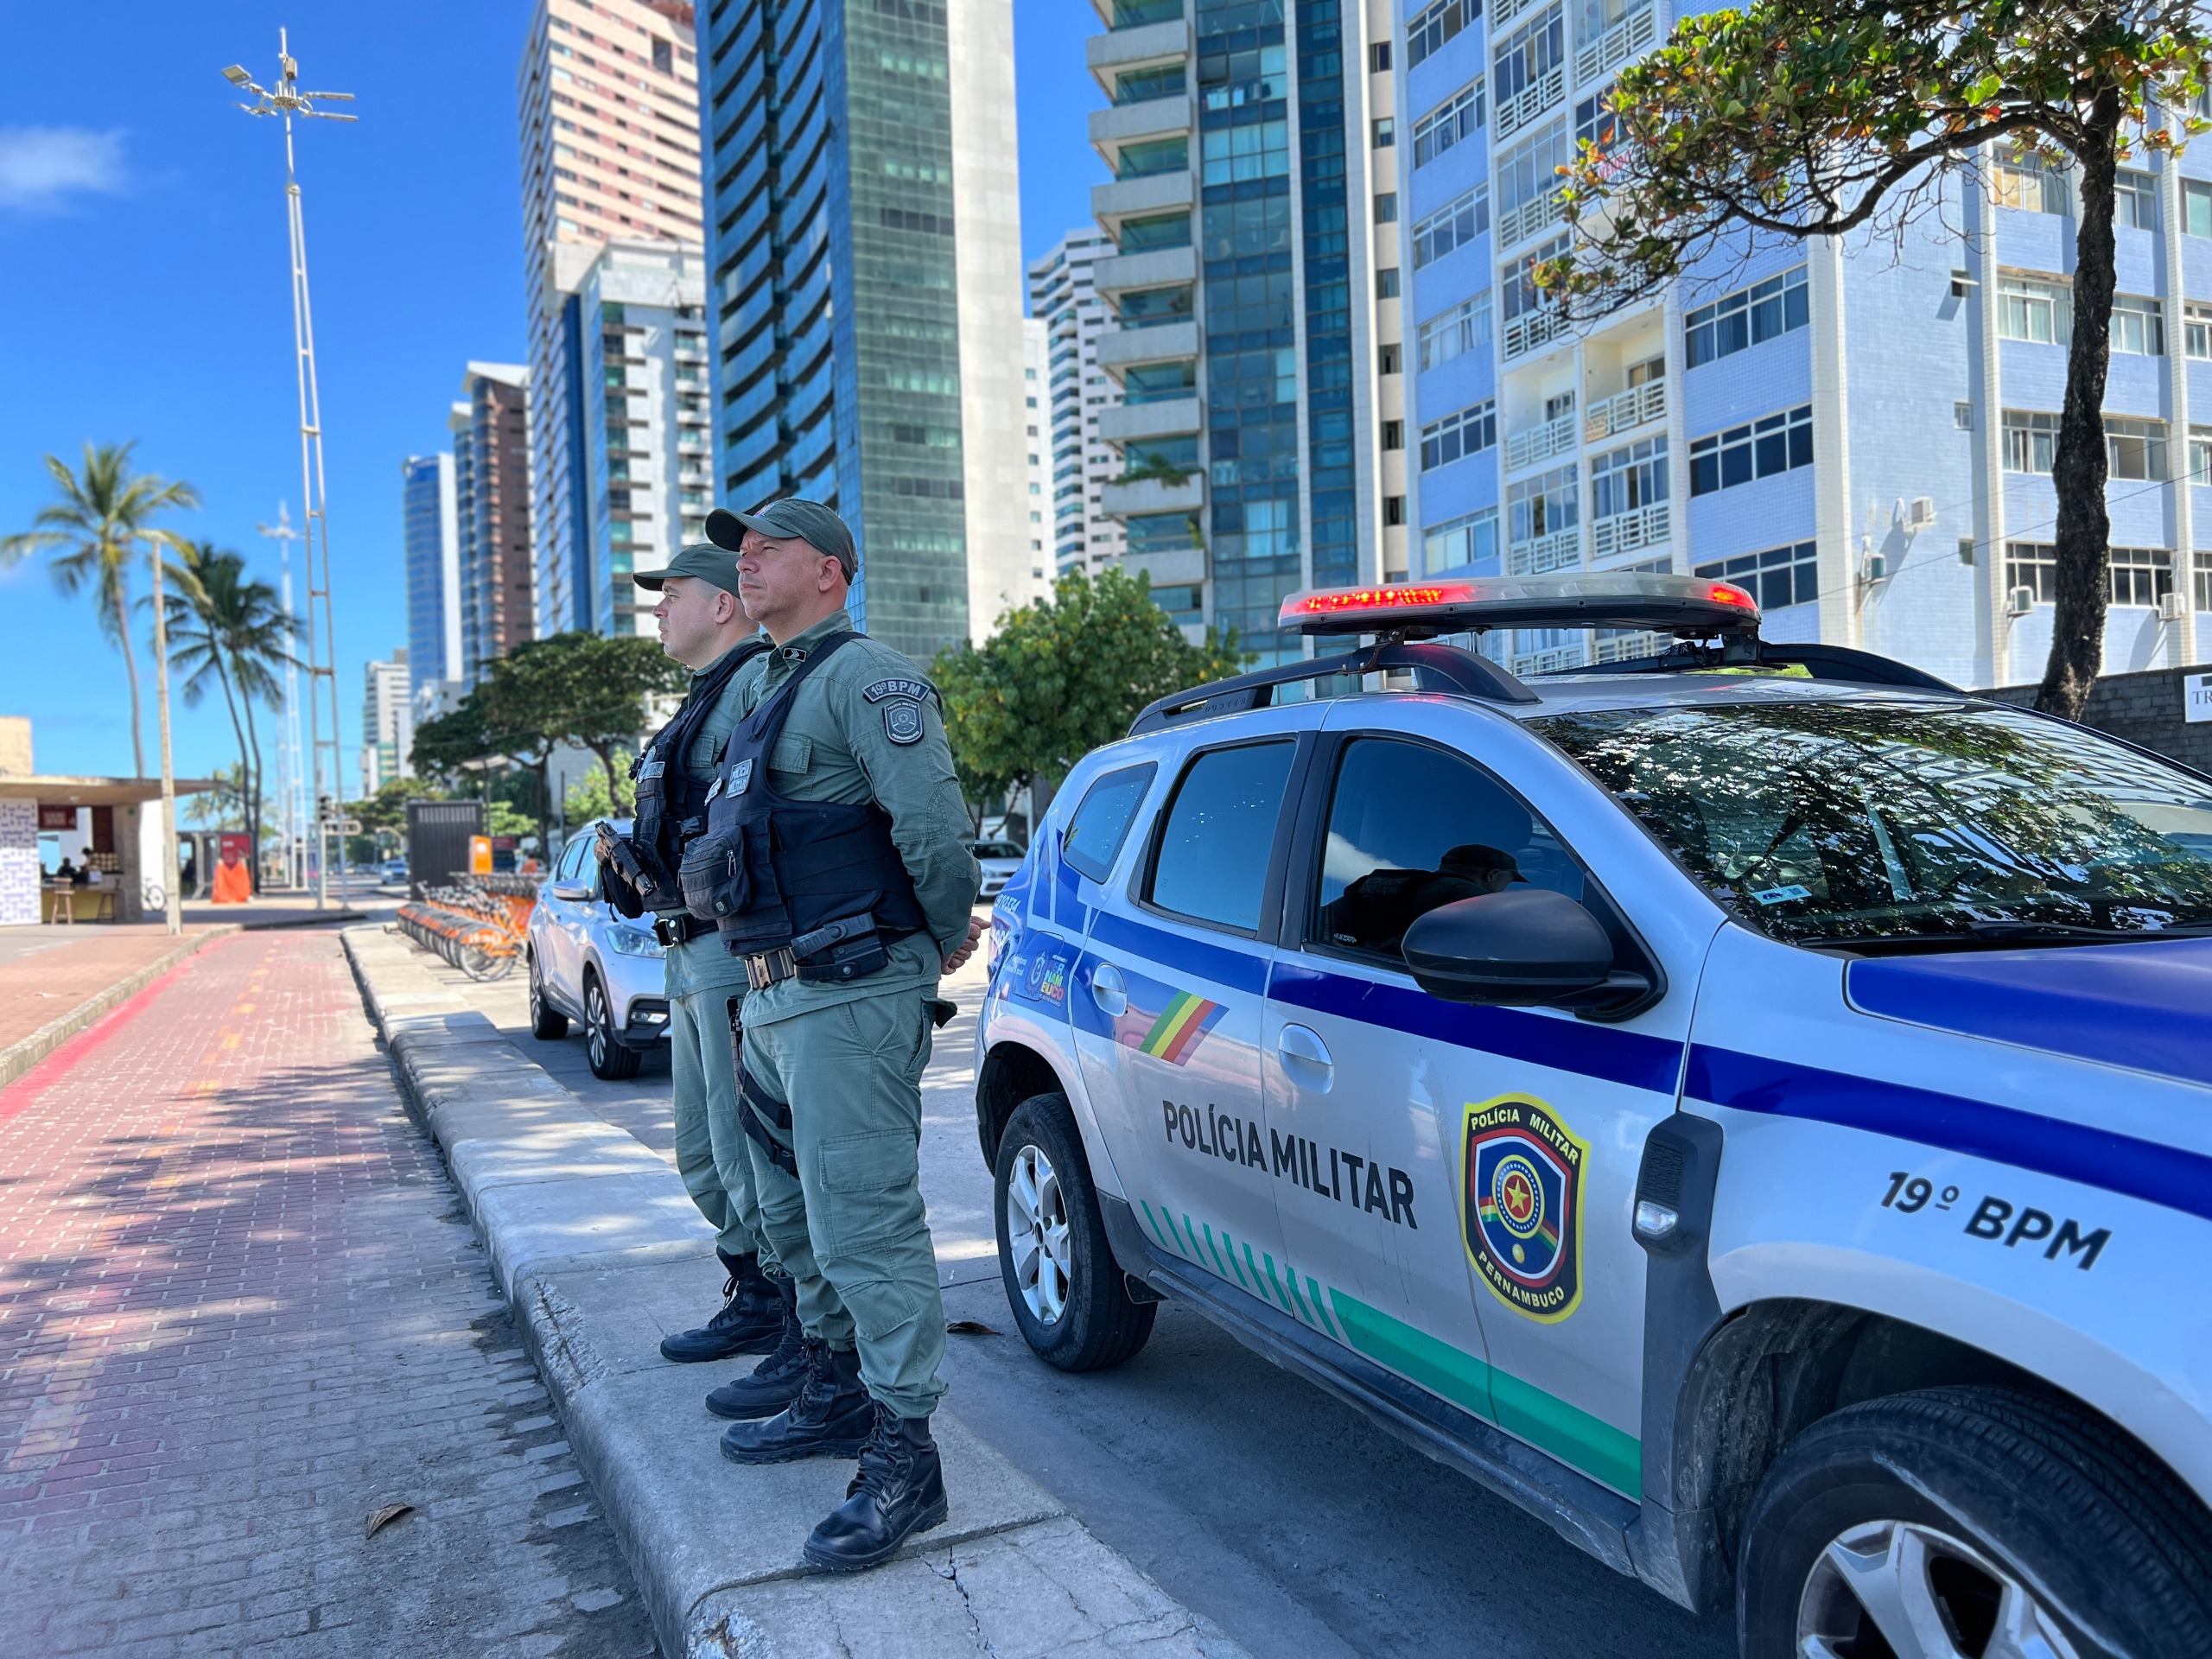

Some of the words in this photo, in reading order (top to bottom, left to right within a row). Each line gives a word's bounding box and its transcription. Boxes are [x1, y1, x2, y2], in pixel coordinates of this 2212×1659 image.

[1205, 698, 1246, 713] DUSTER
[1162, 1099, 1268, 1173] POLÍCIA
[1270, 1128, 1418, 1230] MILITAR
[1471, 1108, 1521, 1131] POLÍCIA
[1529, 1112, 1580, 1166] MILITAR
[1962, 1194, 2113, 1272] BPM
[1478, 1249, 1565, 1308] PERNAMBUCO
